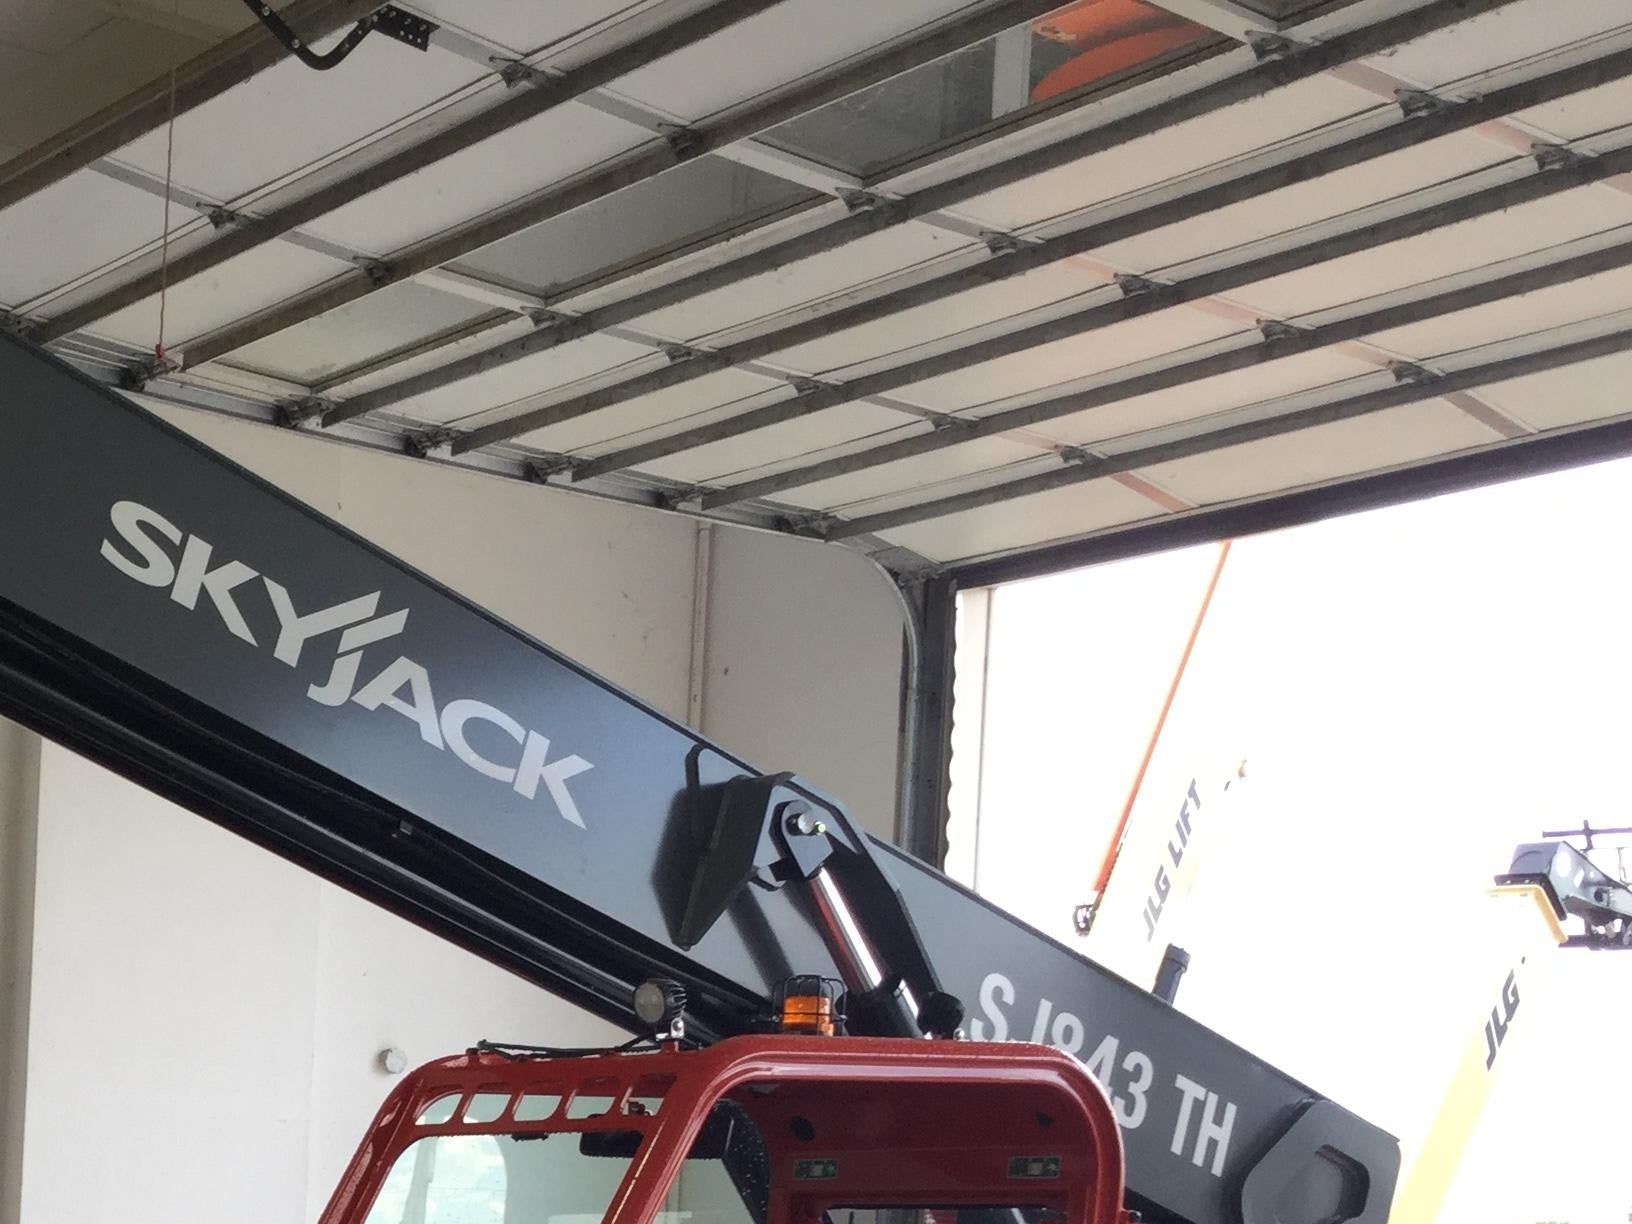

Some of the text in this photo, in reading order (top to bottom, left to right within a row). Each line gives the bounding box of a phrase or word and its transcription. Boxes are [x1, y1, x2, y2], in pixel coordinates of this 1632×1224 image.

[99, 500, 595, 830] SKYJACK
[1142, 777, 1202, 943] JLG LIFT
[1484, 967, 1521, 1073] JLG
[1170, 1073, 1238, 1178] TH
